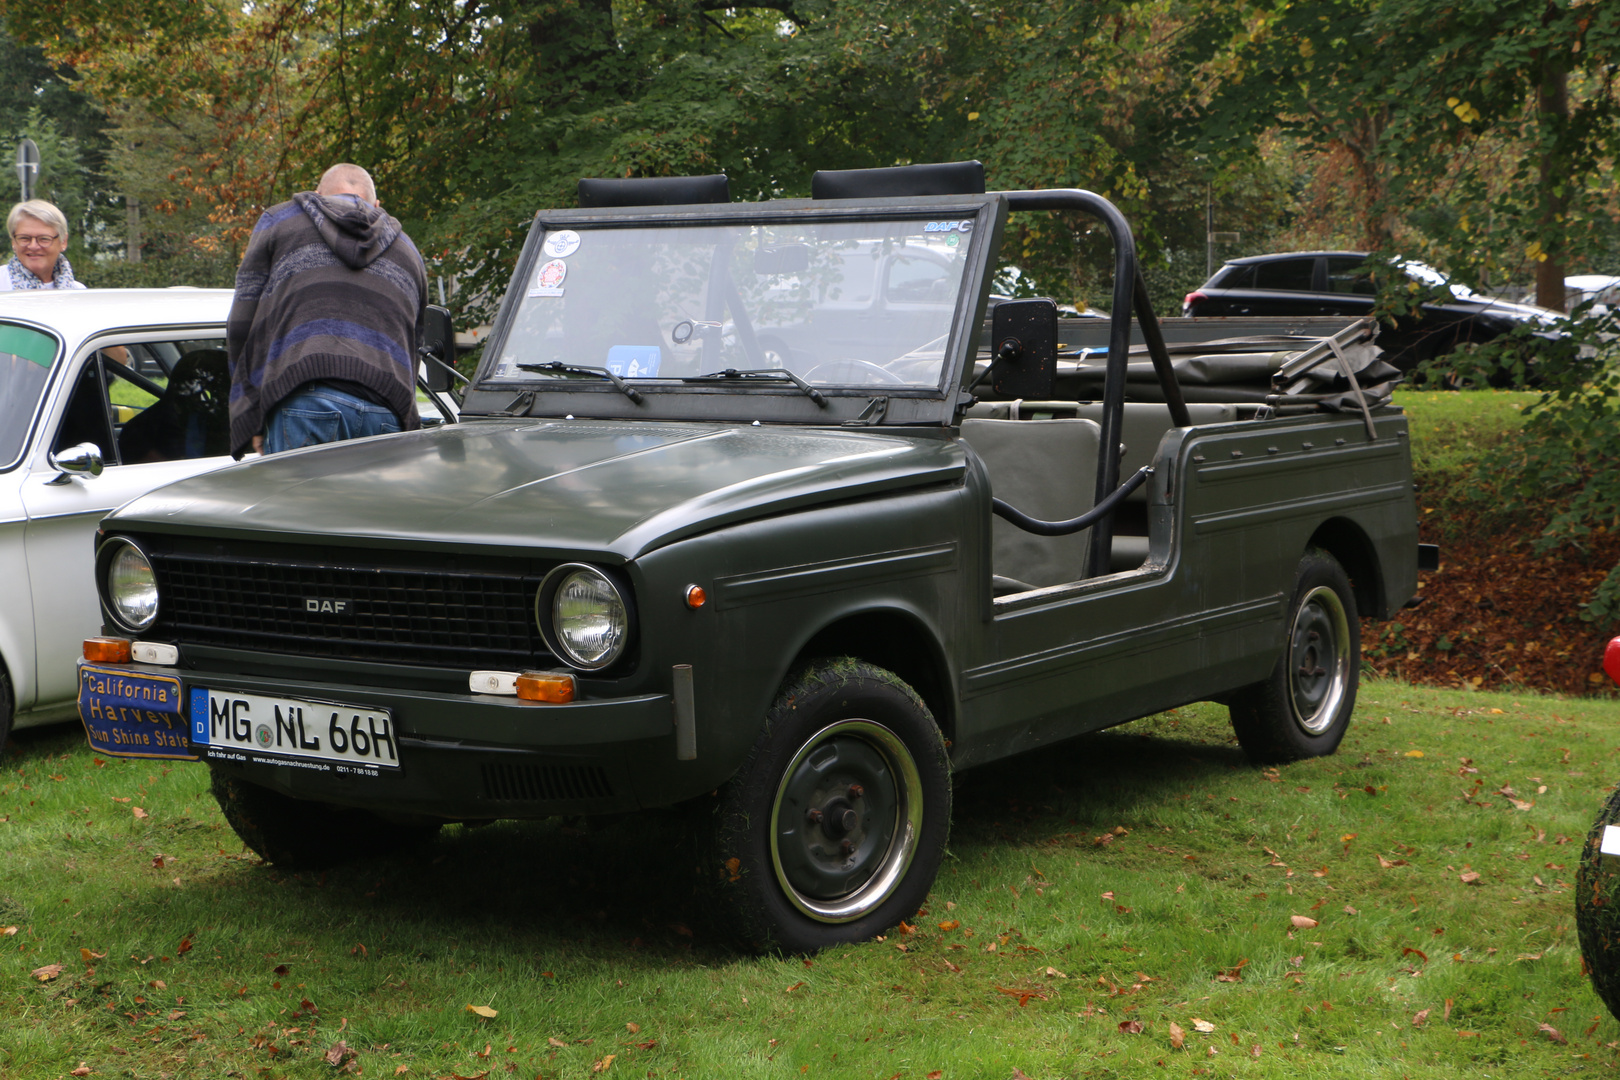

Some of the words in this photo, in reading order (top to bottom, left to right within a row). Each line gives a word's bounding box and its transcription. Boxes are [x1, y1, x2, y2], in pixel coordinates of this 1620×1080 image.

[306, 599, 346, 614] DAF
[88, 675, 167, 703] California
[89, 697, 172, 730] Harvey
[88, 724, 110, 743] Sun
[112, 727, 150, 745] Shine
[154, 730, 189, 748] State
[196, 721, 204, 734] D
[210, 696, 252, 743] MG
[274, 704, 320, 750] NL
[329, 712, 396, 760] 66H
[336, 765, 350, 773] 0211
